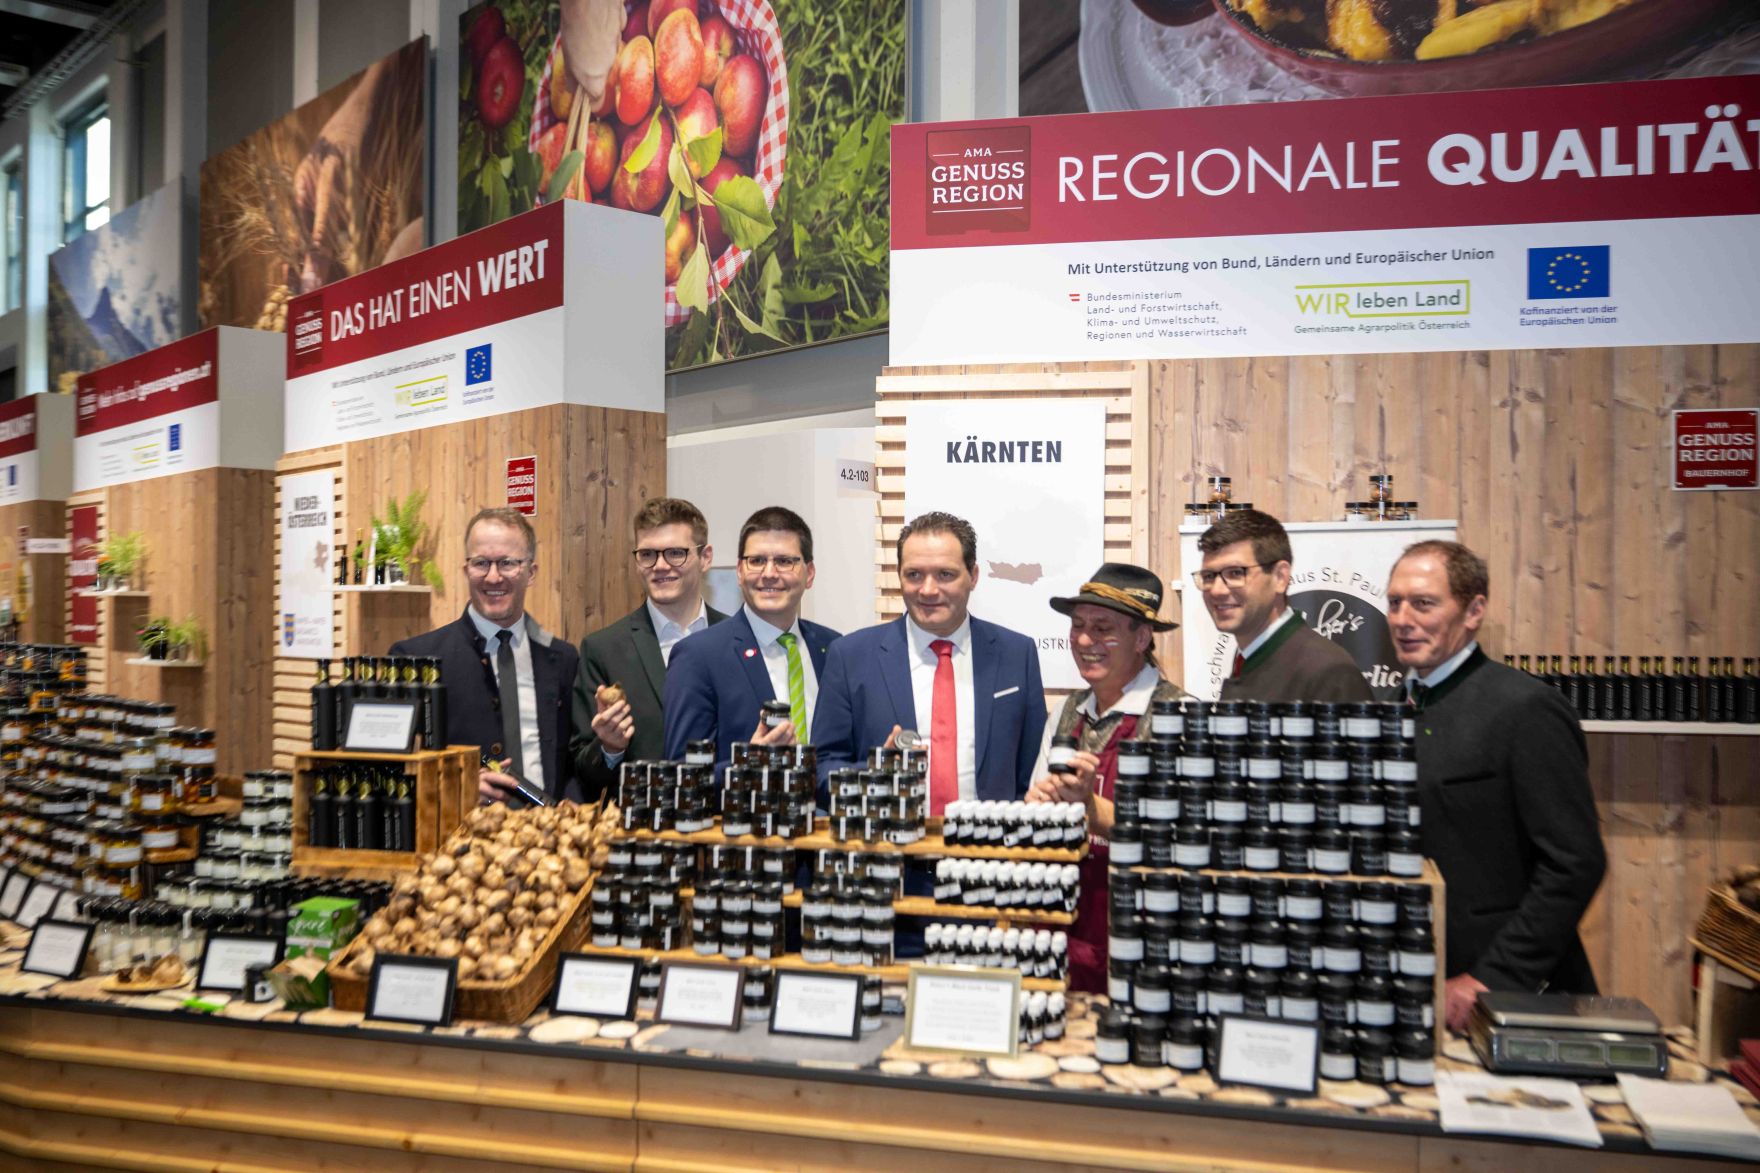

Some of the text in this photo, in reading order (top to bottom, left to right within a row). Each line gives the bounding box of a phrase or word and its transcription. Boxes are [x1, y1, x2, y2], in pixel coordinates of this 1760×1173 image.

[964, 147, 993, 158] AMA
[931, 161, 1025, 184] GENUSS
[1058, 139, 1400, 203] REGIONALE
[932, 183, 1024, 205] REGION
[1068, 246, 1495, 275] Mit Unterstützung von Bund, Ländern und Europäischer Union
[330, 239, 549, 342] DAS HAT EINEN WERT
[1087, 290, 1183, 302] Bundesministerium
[1087, 300, 1223, 315] Land- und Forstwirtschaft,
[1295, 288, 1461, 316] WIR leben Land
[1581, 306, 1599, 314] von
[1600, 304, 1618, 313] der
[1087, 314, 1220, 327] Klima- und Umweltschutz,
[1294, 319, 1471, 334] Gemeinsame Agrarpolitik Österreich
[1519, 315, 1617, 327] Europäischen Union
[1087, 326, 1248, 342] Regionen und Wasserwirtschaft
[1679, 433, 1754, 446] GENUSS
[946, 435, 1062, 463] KÄRNTEN
[1680, 448, 1754, 461] REGION
[840, 468, 869, 482] 4.2-103
[1683, 469, 1750, 477] BAUERNHOF
[1321, 566, 1343, 584] St.
[1037, 637, 1072, 650] STRI
[1206, 633, 1230, 685] schwa
[1362, 664, 1404, 688] rlic
